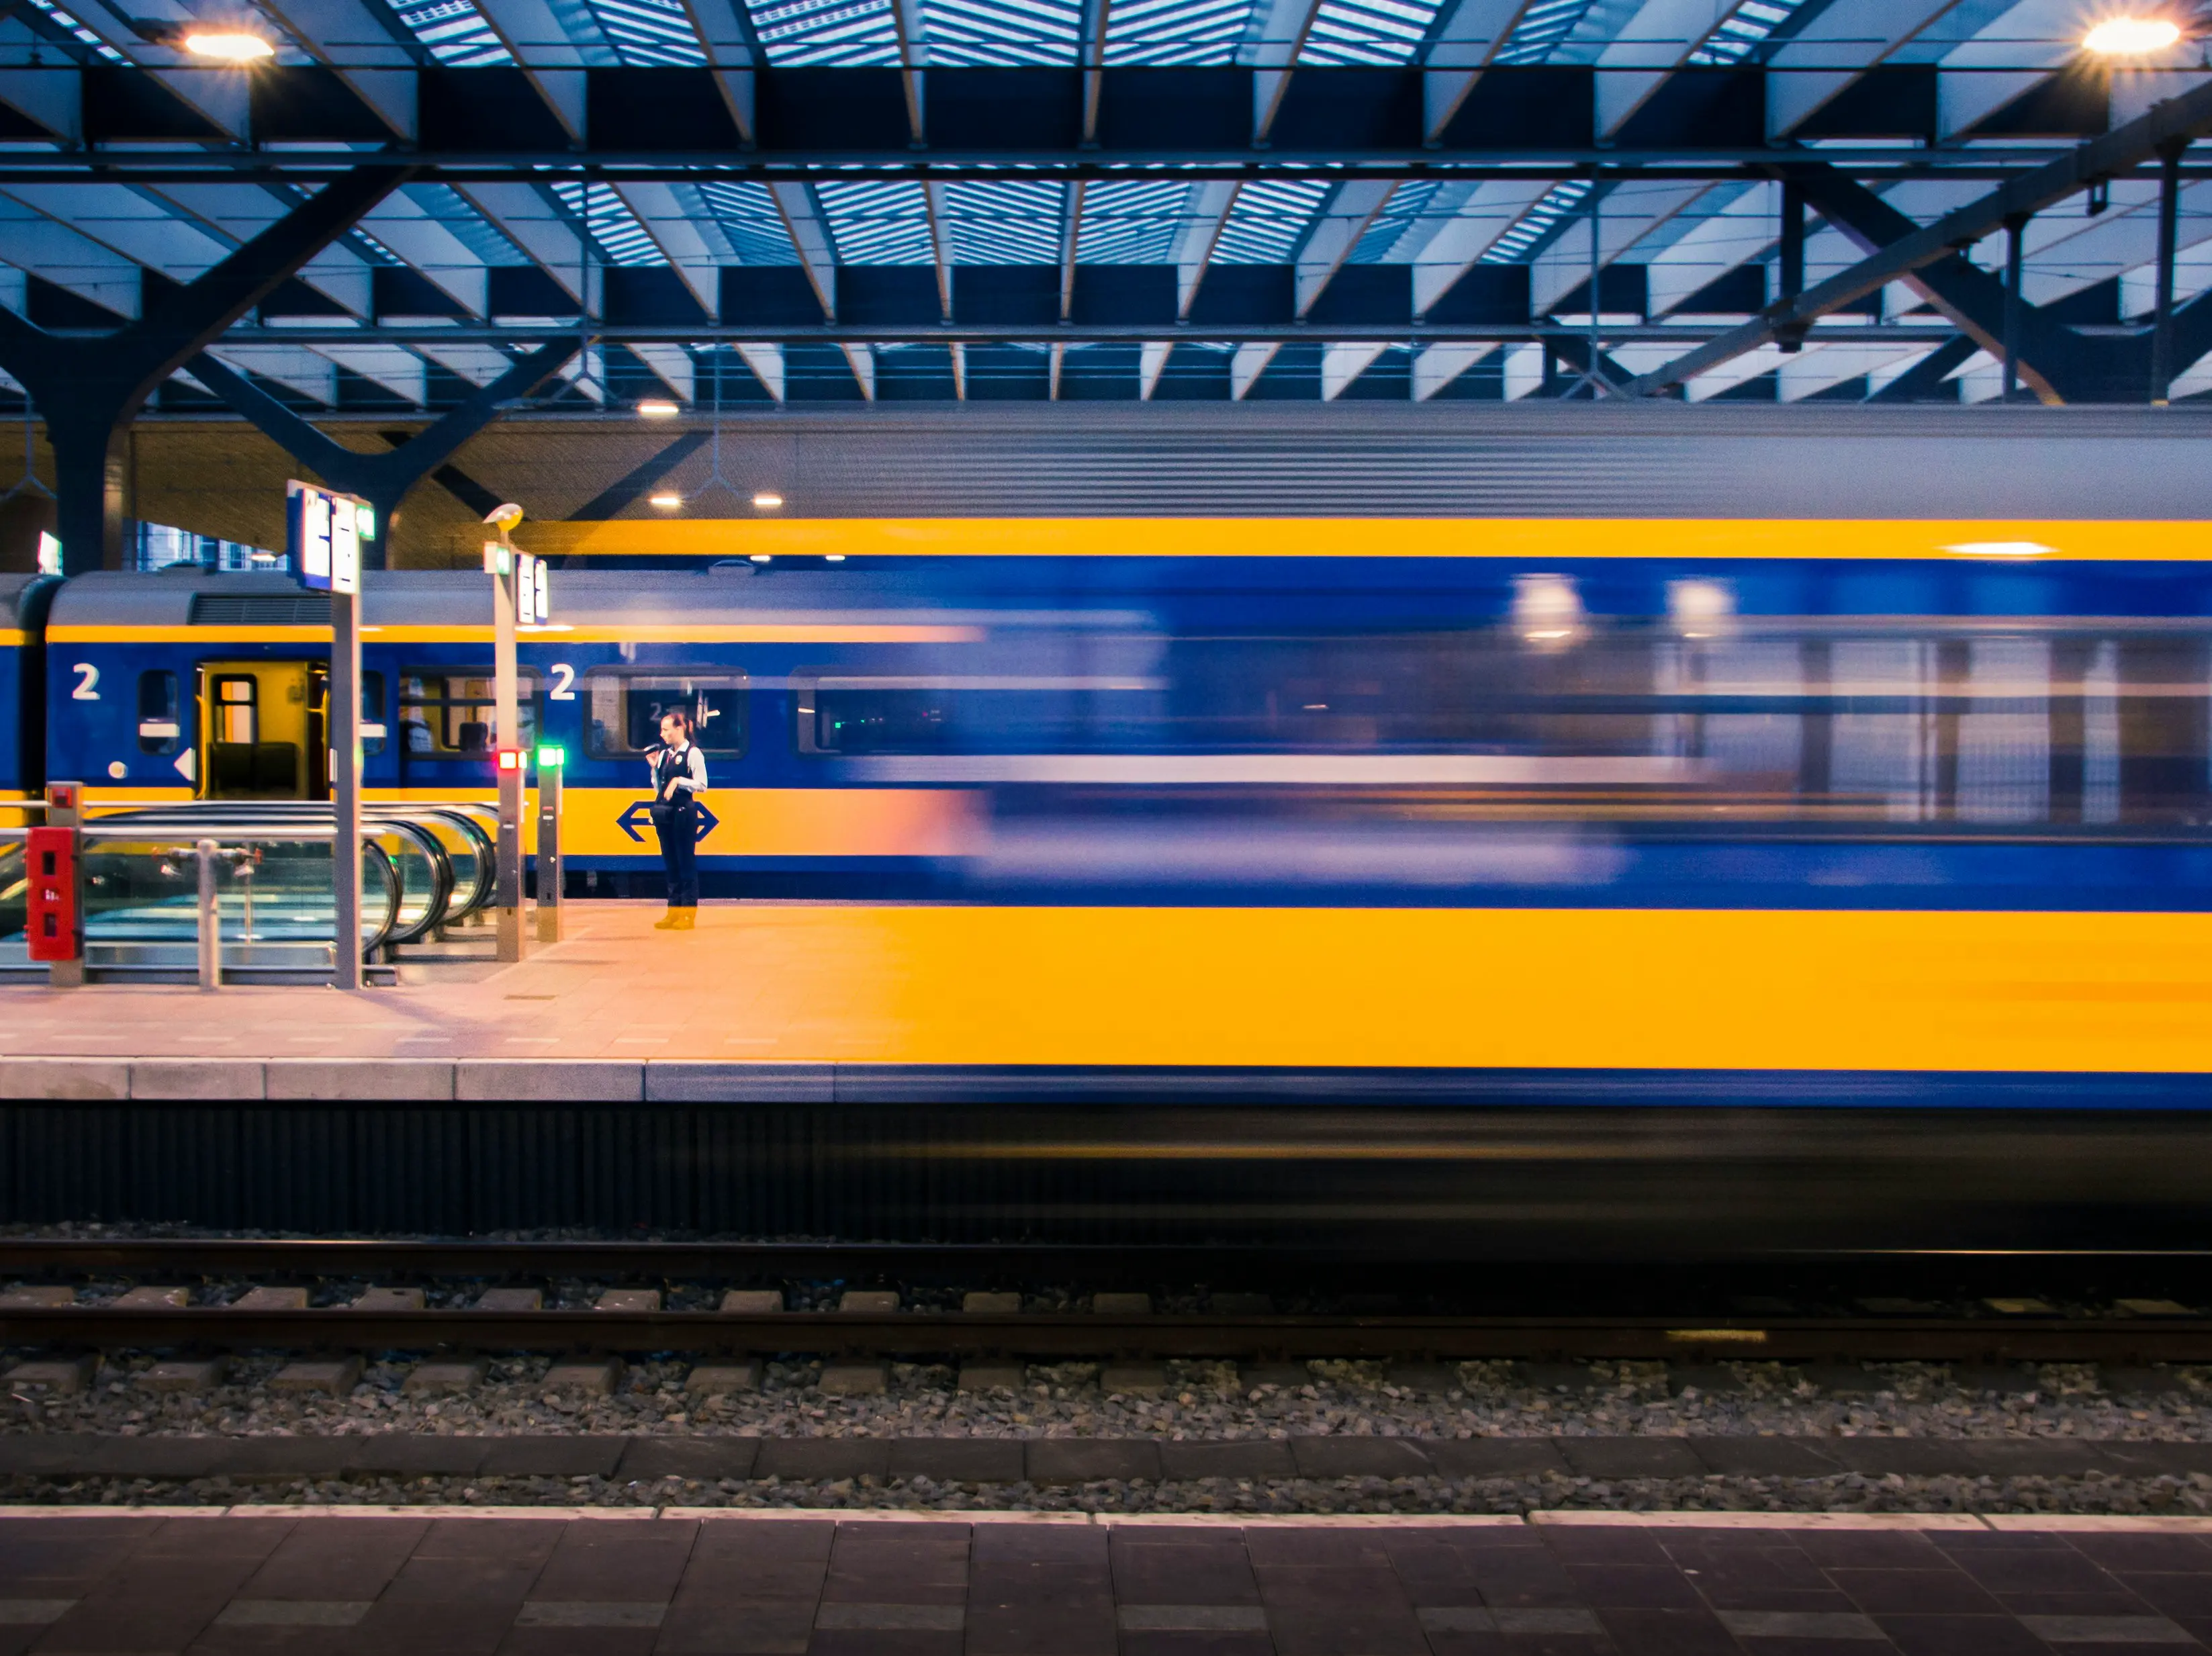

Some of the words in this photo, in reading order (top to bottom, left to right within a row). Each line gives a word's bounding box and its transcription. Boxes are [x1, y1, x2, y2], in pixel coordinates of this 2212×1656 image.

[72, 662, 101, 700] 2
[550, 663, 575, 700] 2
[649, 702, 662, 721] 2
